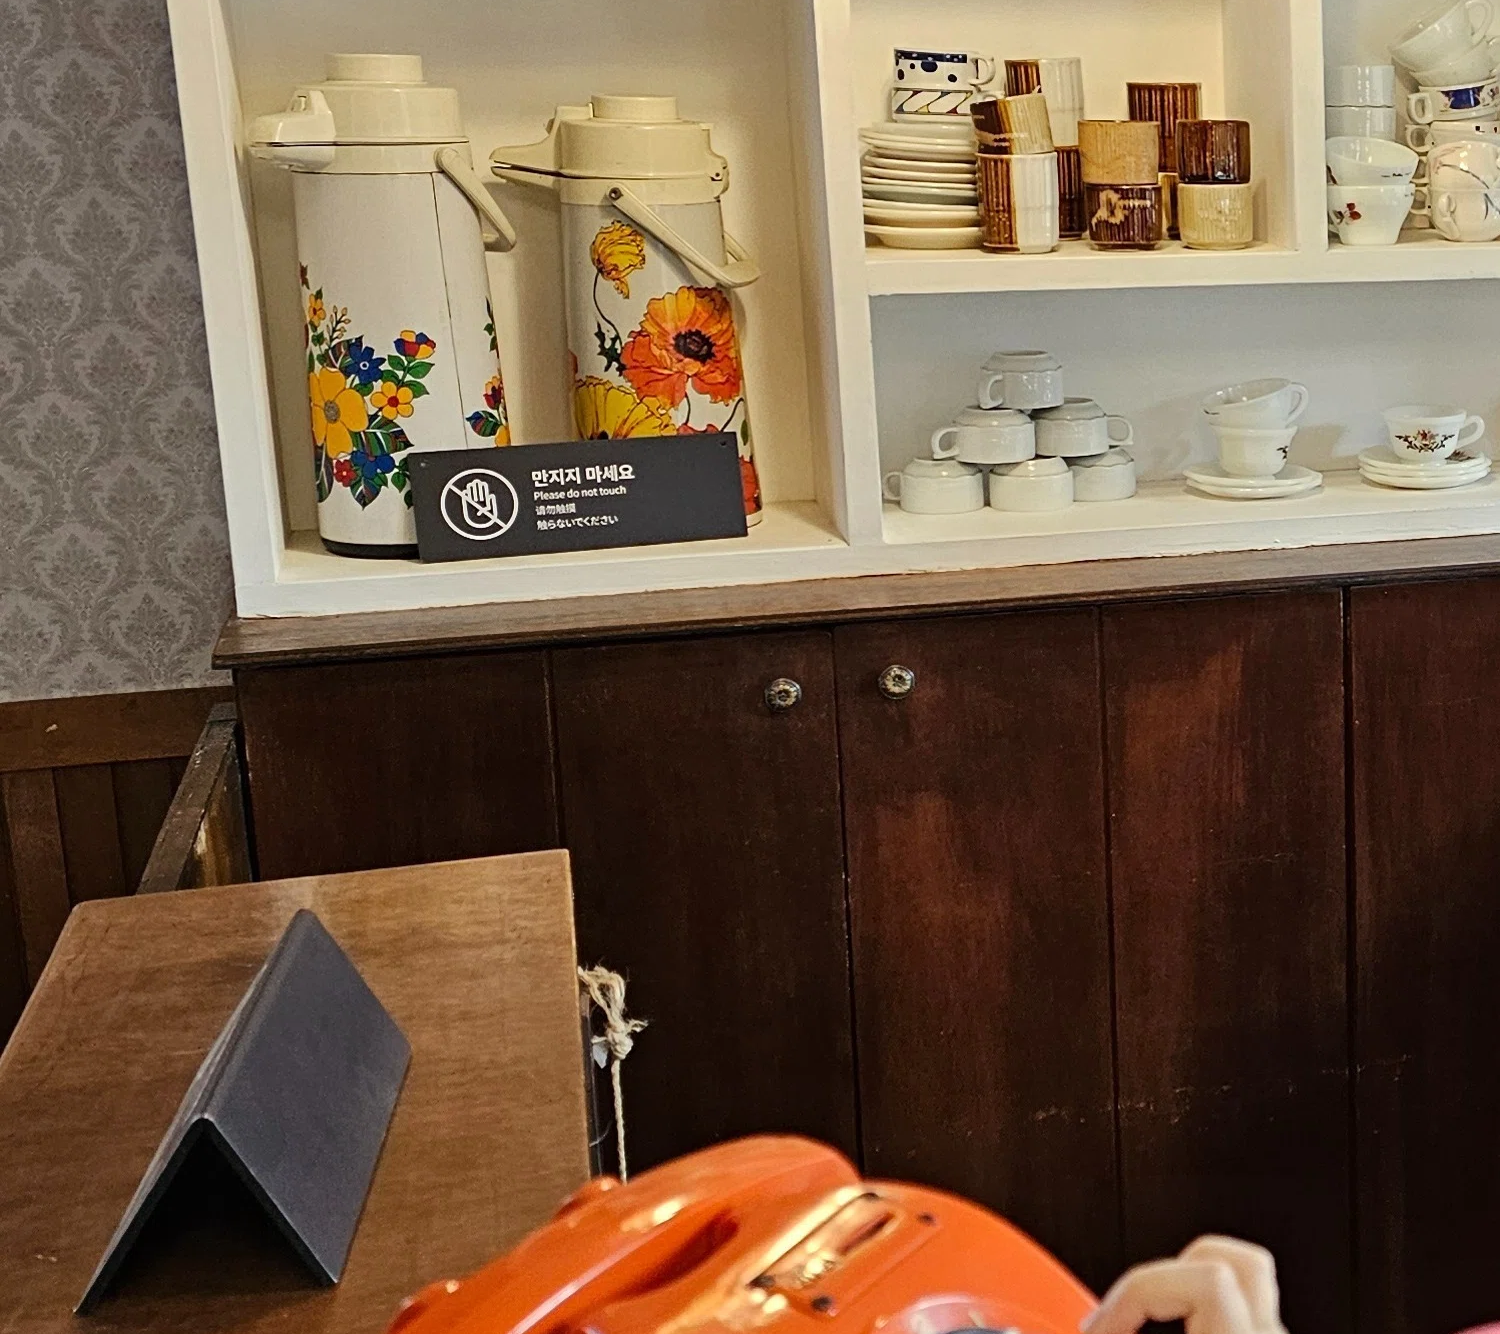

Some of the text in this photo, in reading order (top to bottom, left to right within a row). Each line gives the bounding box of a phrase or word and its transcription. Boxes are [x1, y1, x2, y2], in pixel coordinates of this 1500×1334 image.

[531, 464, 635, 487] 만지지 마세요
[534, 485, 627, 500] Please do not touch
[537, 515, 619, 531] 触らないでください
